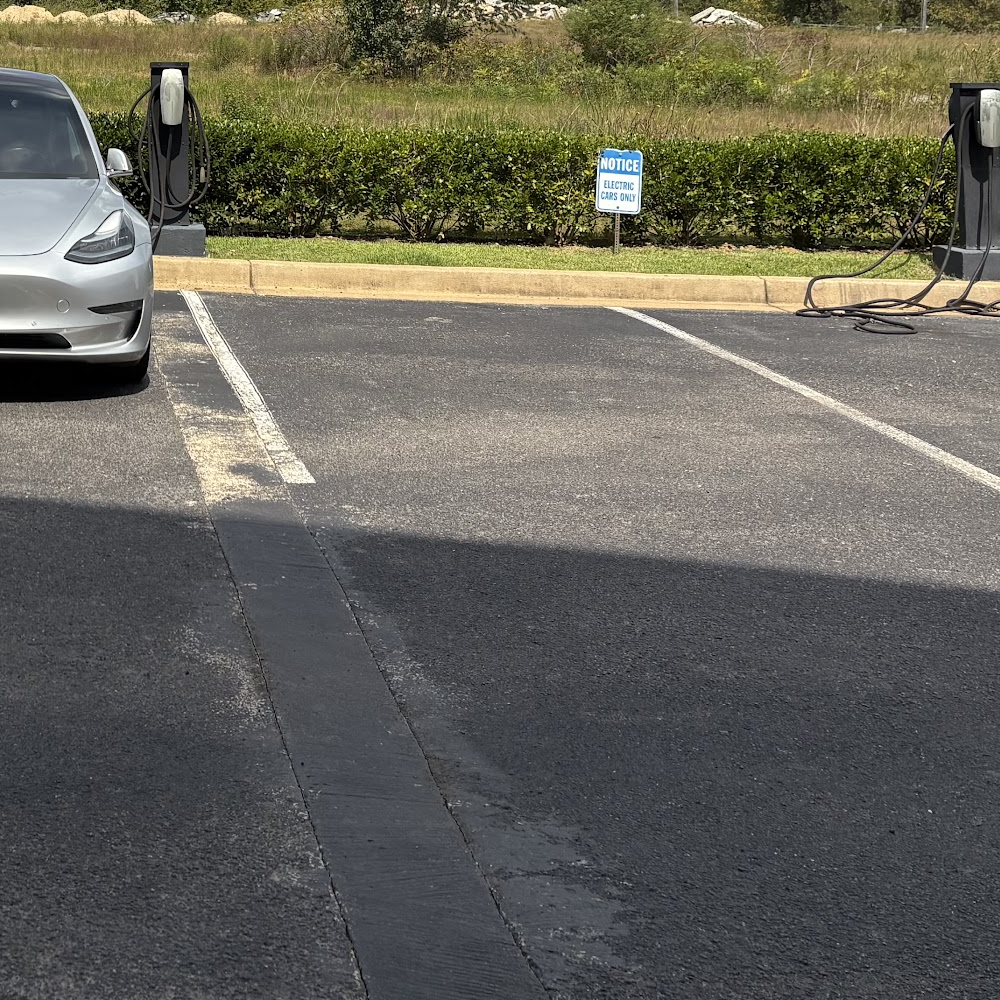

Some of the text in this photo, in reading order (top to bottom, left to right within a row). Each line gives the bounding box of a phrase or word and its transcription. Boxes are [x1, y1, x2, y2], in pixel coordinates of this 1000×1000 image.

[600, 157, 639, 172] NOTICE
[603, 180, 635, 191] ELECTRIC
[600, 191, 637, 202] CARS ONLY
